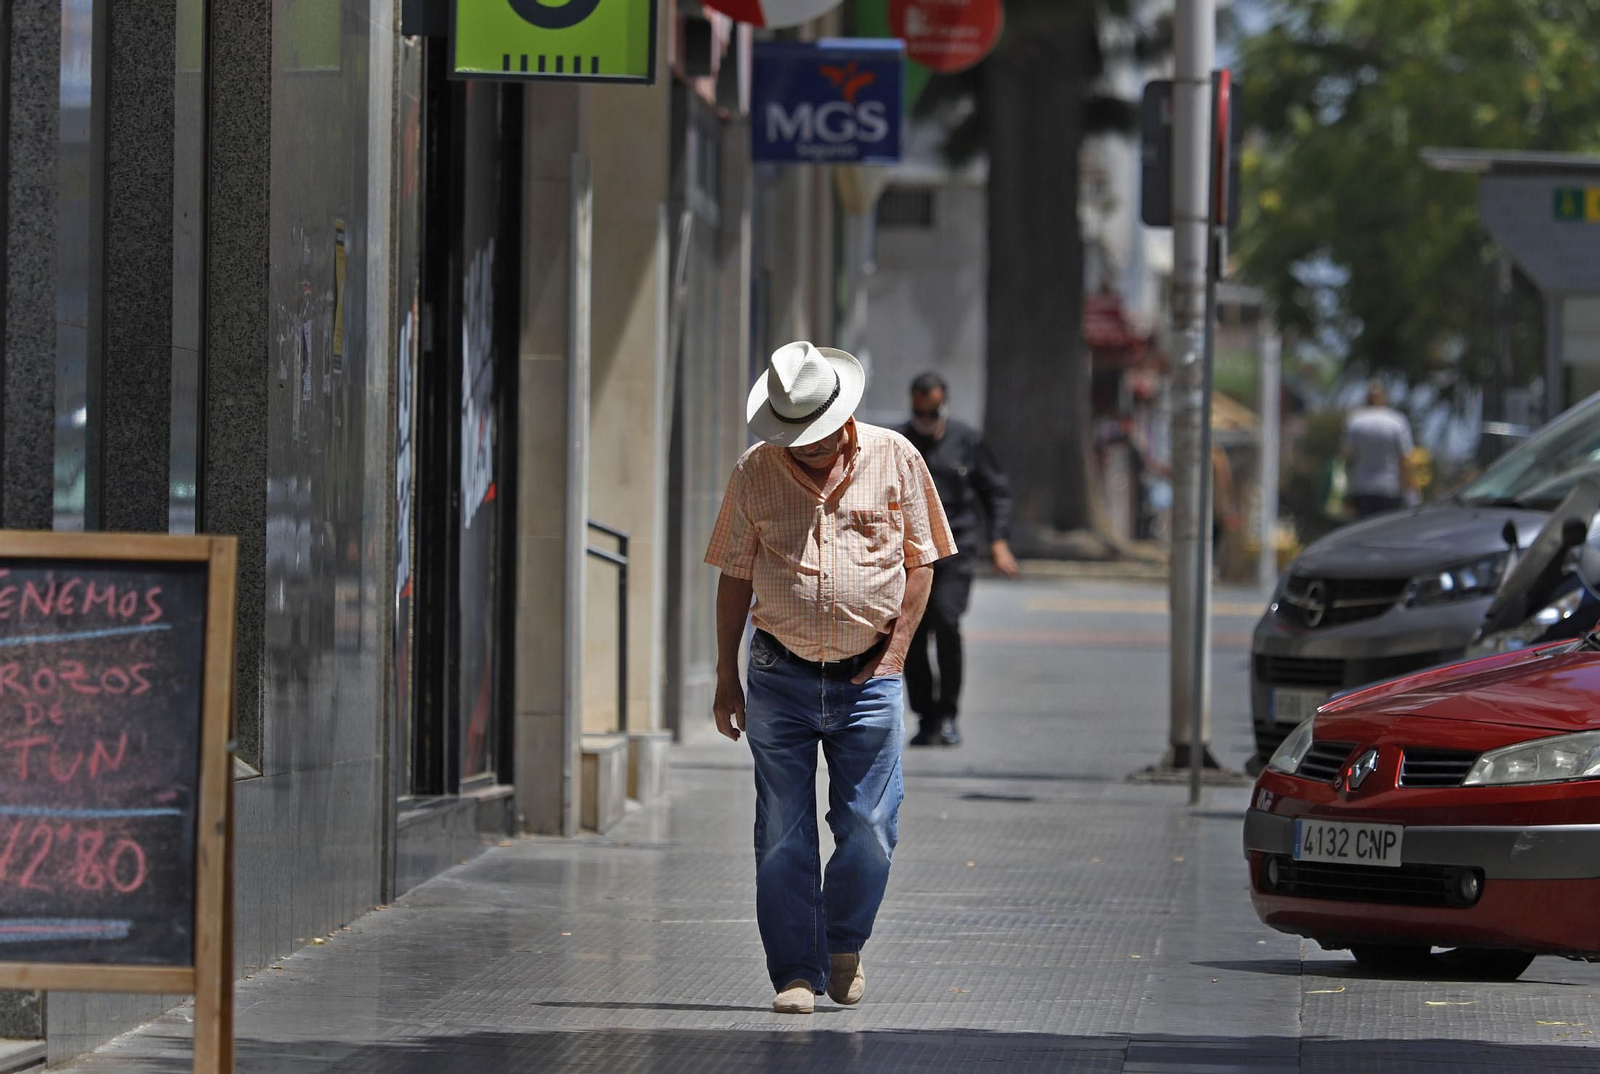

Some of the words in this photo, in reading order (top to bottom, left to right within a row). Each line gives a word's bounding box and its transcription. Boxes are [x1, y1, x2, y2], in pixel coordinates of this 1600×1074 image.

[766, 100, 888, 142] MGS
[23, 701, 66, 726] DE
[1304, 826, 1349, 857] 4132
[1356, 829, 1396, 860] CNP
